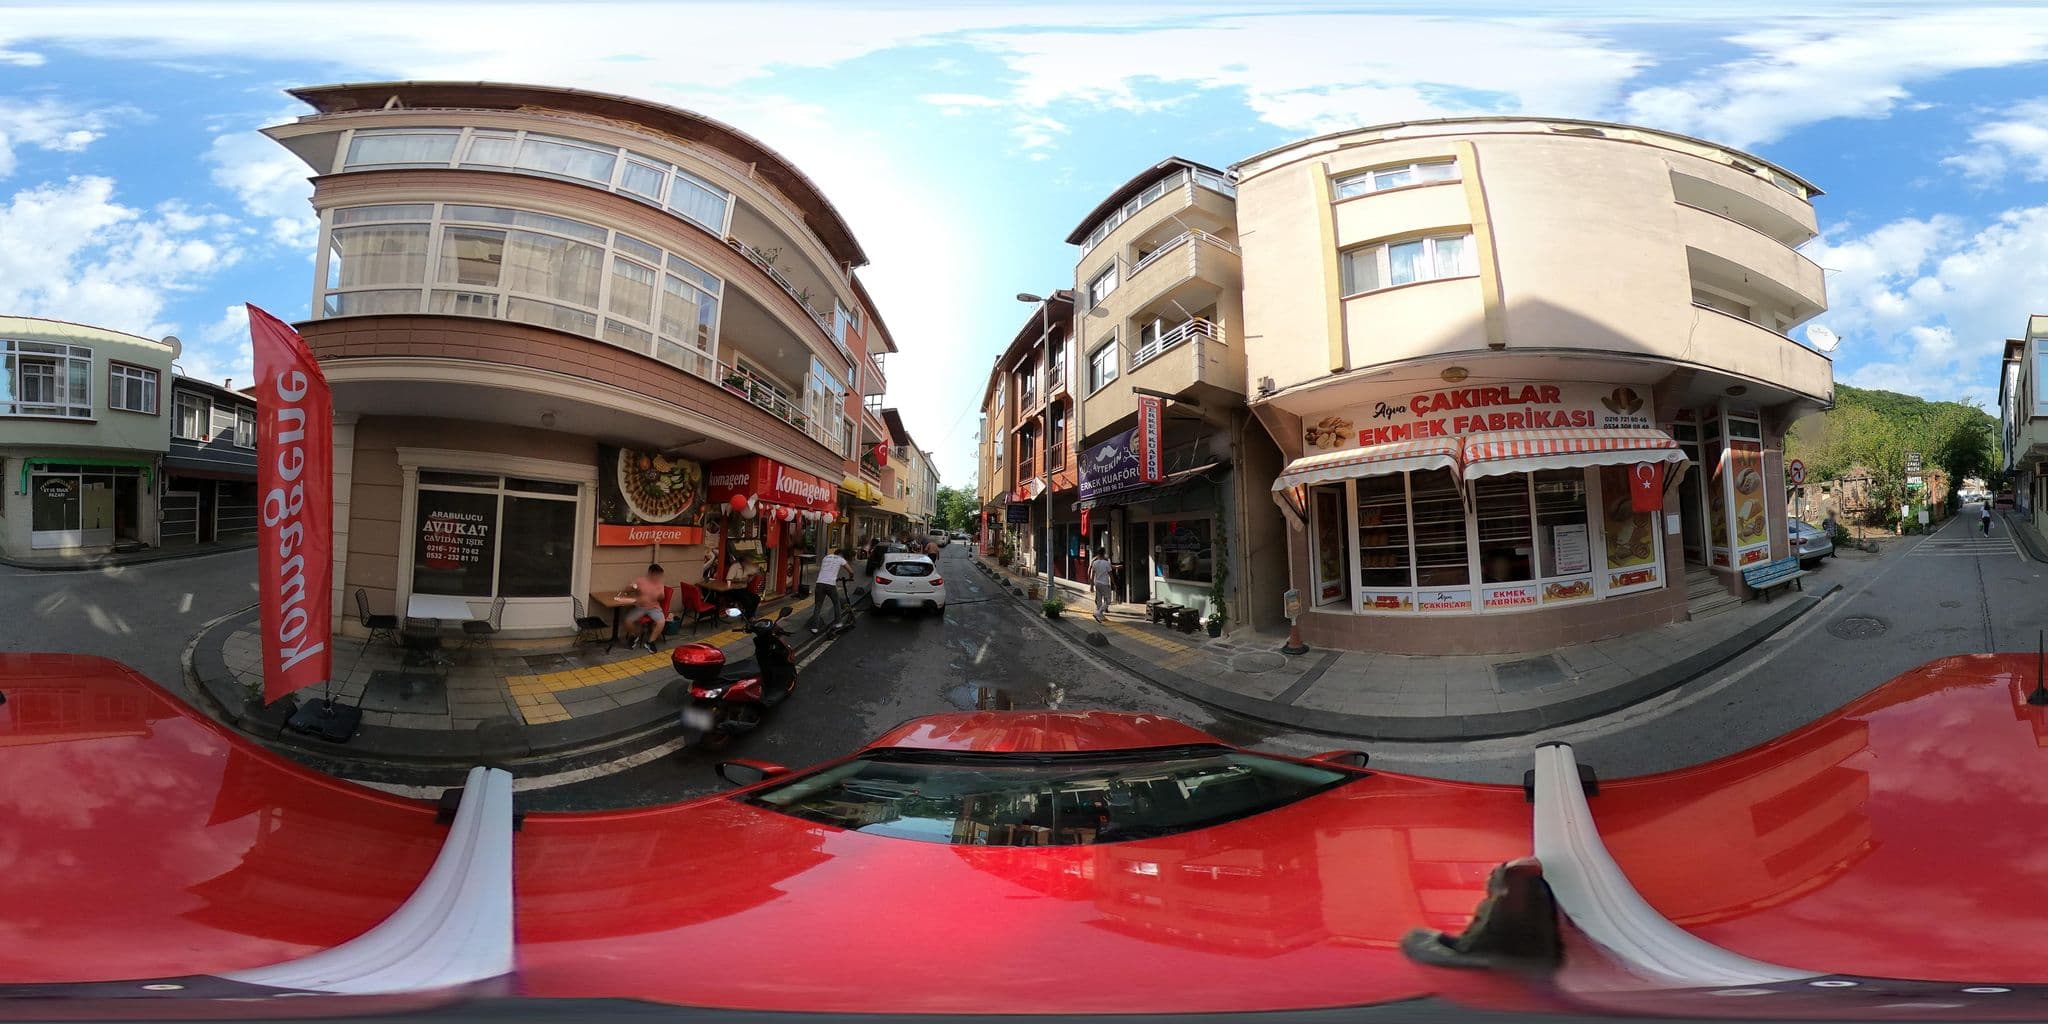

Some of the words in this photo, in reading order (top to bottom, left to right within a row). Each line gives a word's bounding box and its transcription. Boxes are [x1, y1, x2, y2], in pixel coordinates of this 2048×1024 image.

[1410, 384, 1561, 417] ÇAKIRLAR
[1359, 419, 1448, 446] EKMEK
[1454, 407, 1595, 434] FABRİKASI
[708, 471, 750, 490] komagene
[776, 466, 831, 503] komagene
[1081, 478, 1101, 491] ERKEK
[263, 370, 324, 672] komagene
[432, 511, 483, 521] ARABULUCU
[423, 520, 488, 536] AVUKAT
[629, 528, 681, 542] komagene
[1485, 596, 1535, 606] FABRİKASI
[1493, 590, 1525, 598] EKMEK
